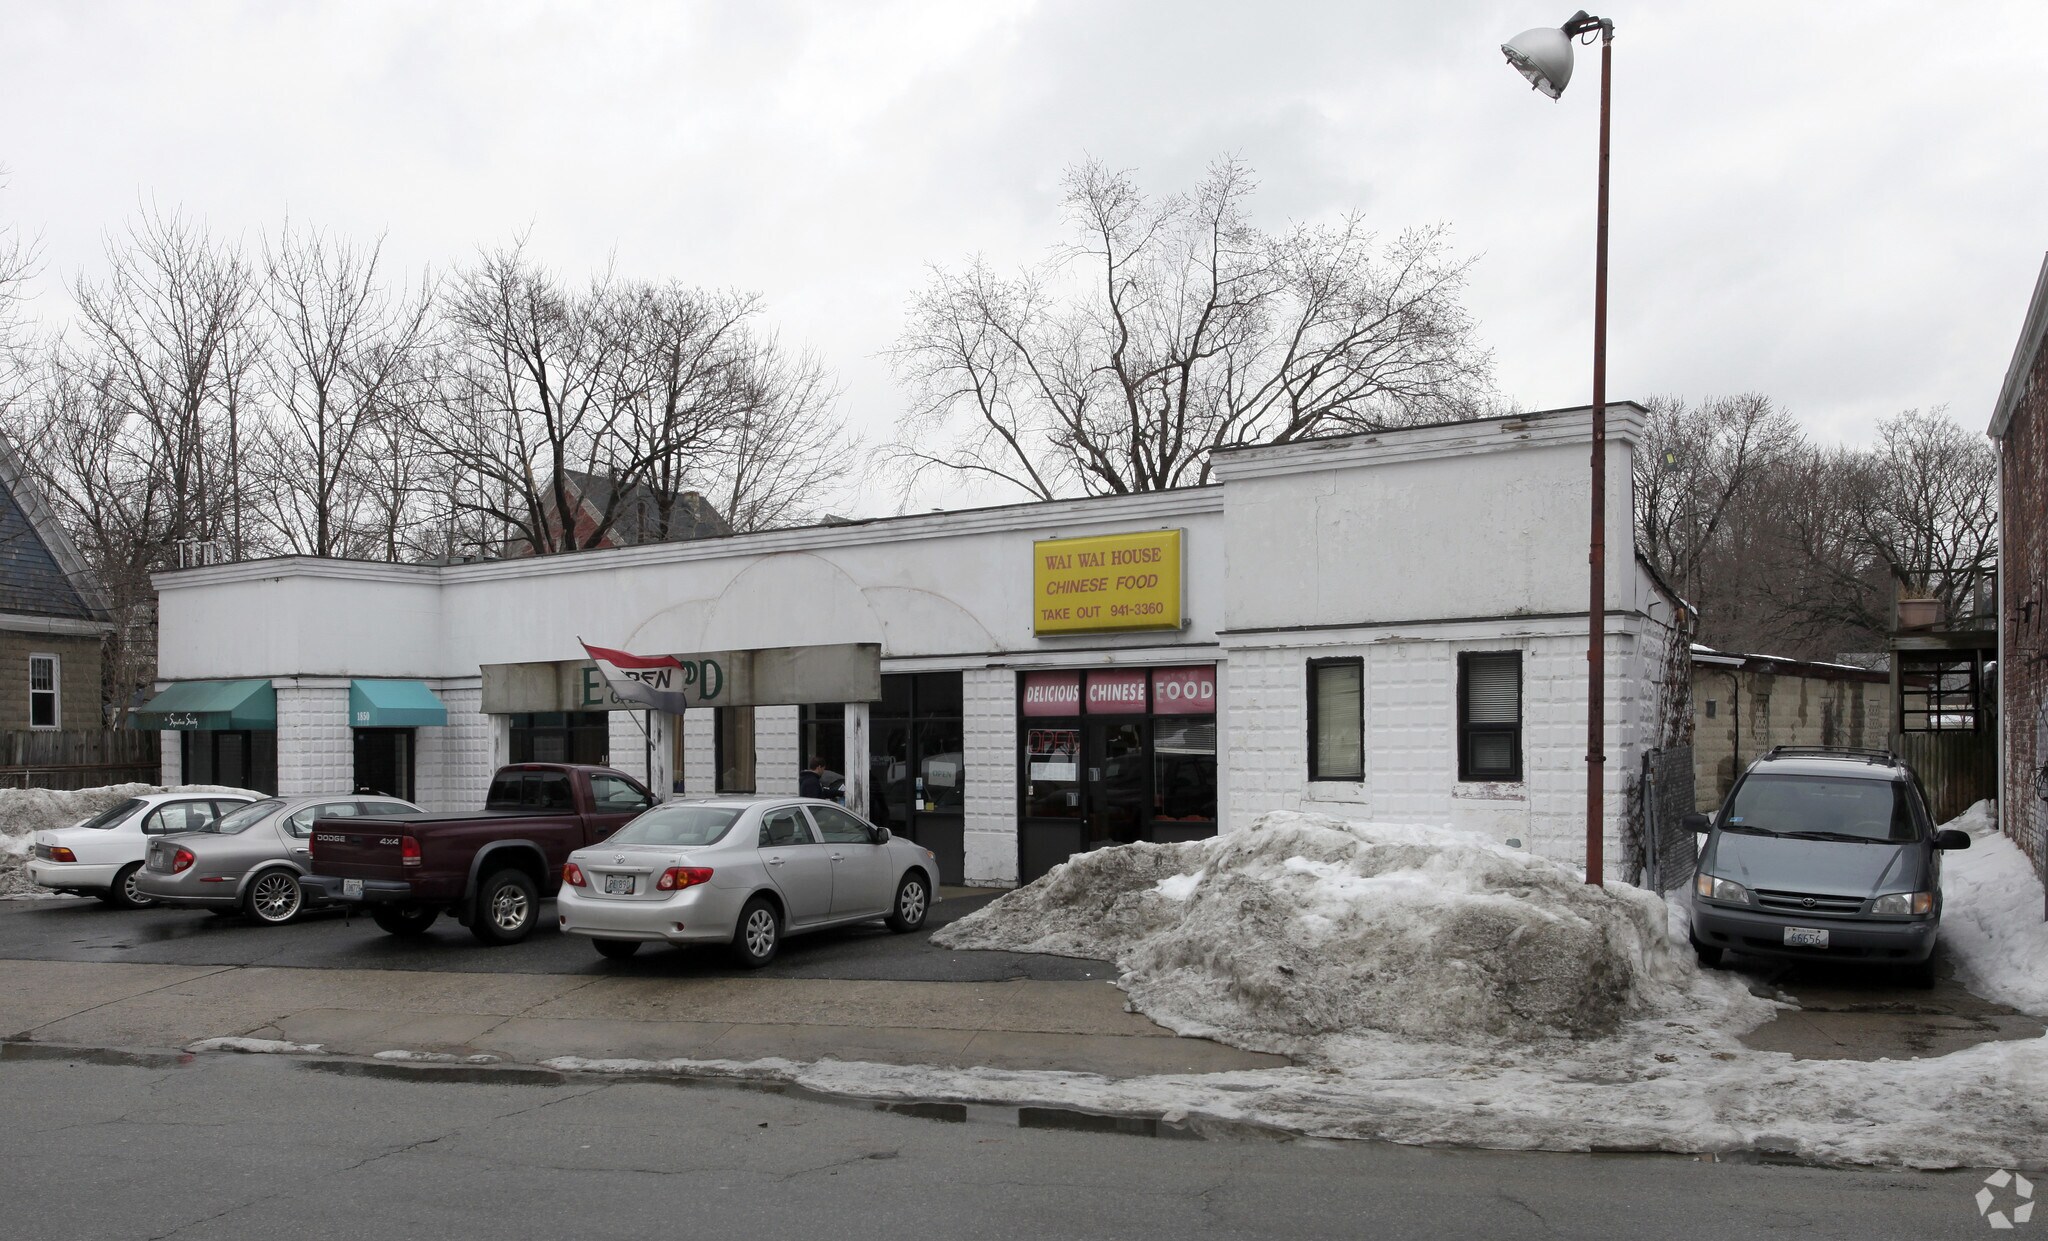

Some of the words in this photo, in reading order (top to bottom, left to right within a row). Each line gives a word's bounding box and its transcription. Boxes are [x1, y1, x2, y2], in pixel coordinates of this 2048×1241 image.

[1045, 554, 1072, 570] WAI
[1078, 551, 1106, 568] WAI
[1111, 547, 1162, 566] HOUSE
[1046, 577, 1109, 596] CHINESE
[1116, 573, 1159, 591] FOOD
[1041, 608, 1070, 621] TAKE
[1076, 605, 1102, 618] OUT
[1110, 602, 1164, 617] 941-3360
[1026, 684, 1080, 703] DELICIOUS
[1089, 683, 1145, 702] CHINESE
[1155, 681, 1214, 700] FOOD
[356, 711, 370, 721] 1850
[931, 769, 952, 779] OPEN
[317, 834, 346, 843] DODGE
